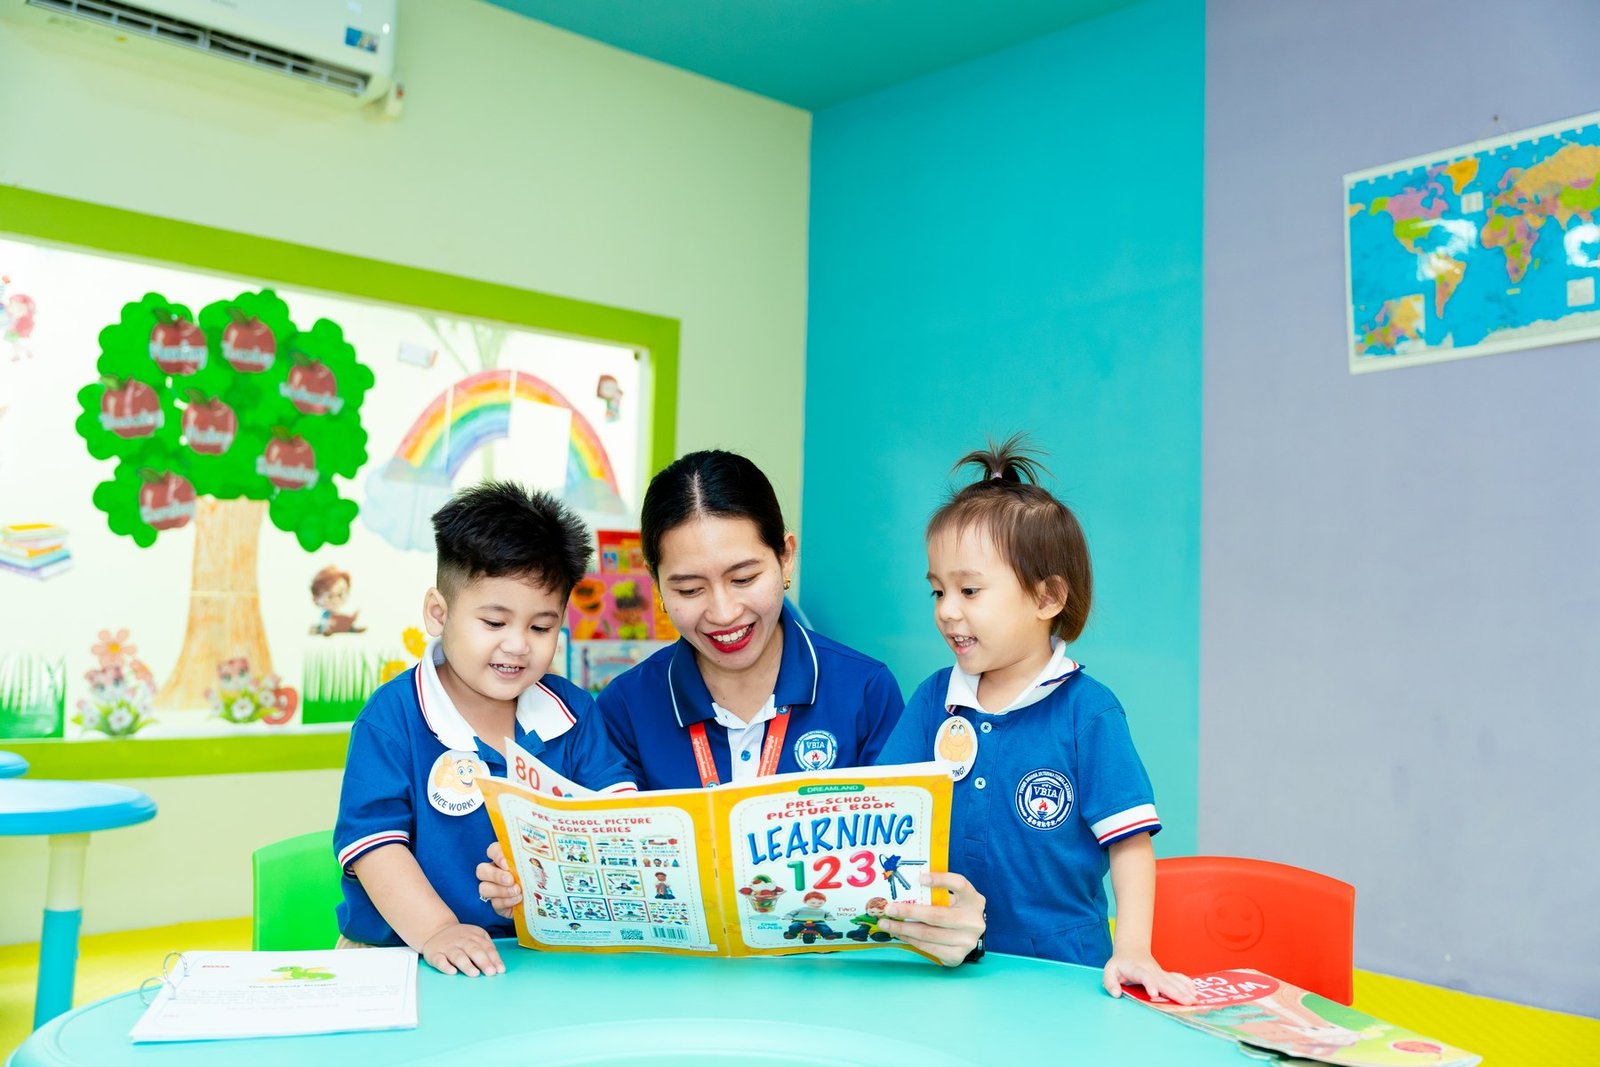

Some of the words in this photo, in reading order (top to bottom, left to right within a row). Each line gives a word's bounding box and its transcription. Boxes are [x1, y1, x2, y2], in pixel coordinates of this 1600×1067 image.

[806, 741, 825, 749] VBIA
[515, 755, 540, 791] 80
[806, 785, 859, 793] DREAMLAND
[1033, 786, 1058, 798] VBIA
[432, 791, 449, 809] NICE
[449, 798, 476, 812] WORK!
[785, 795, 880, 809] PRE-SCHOOL
[766, 805, 842, 820] PICTURE
[849, 802, 895, 811] BOOK
[531, 811, 600, 826] PRE-SCHOOL
[604, 817, 652, 825] PICTURE
[552, 824, 588, 833] BOOKS
[747, 813, 914, 866] LEARNING
